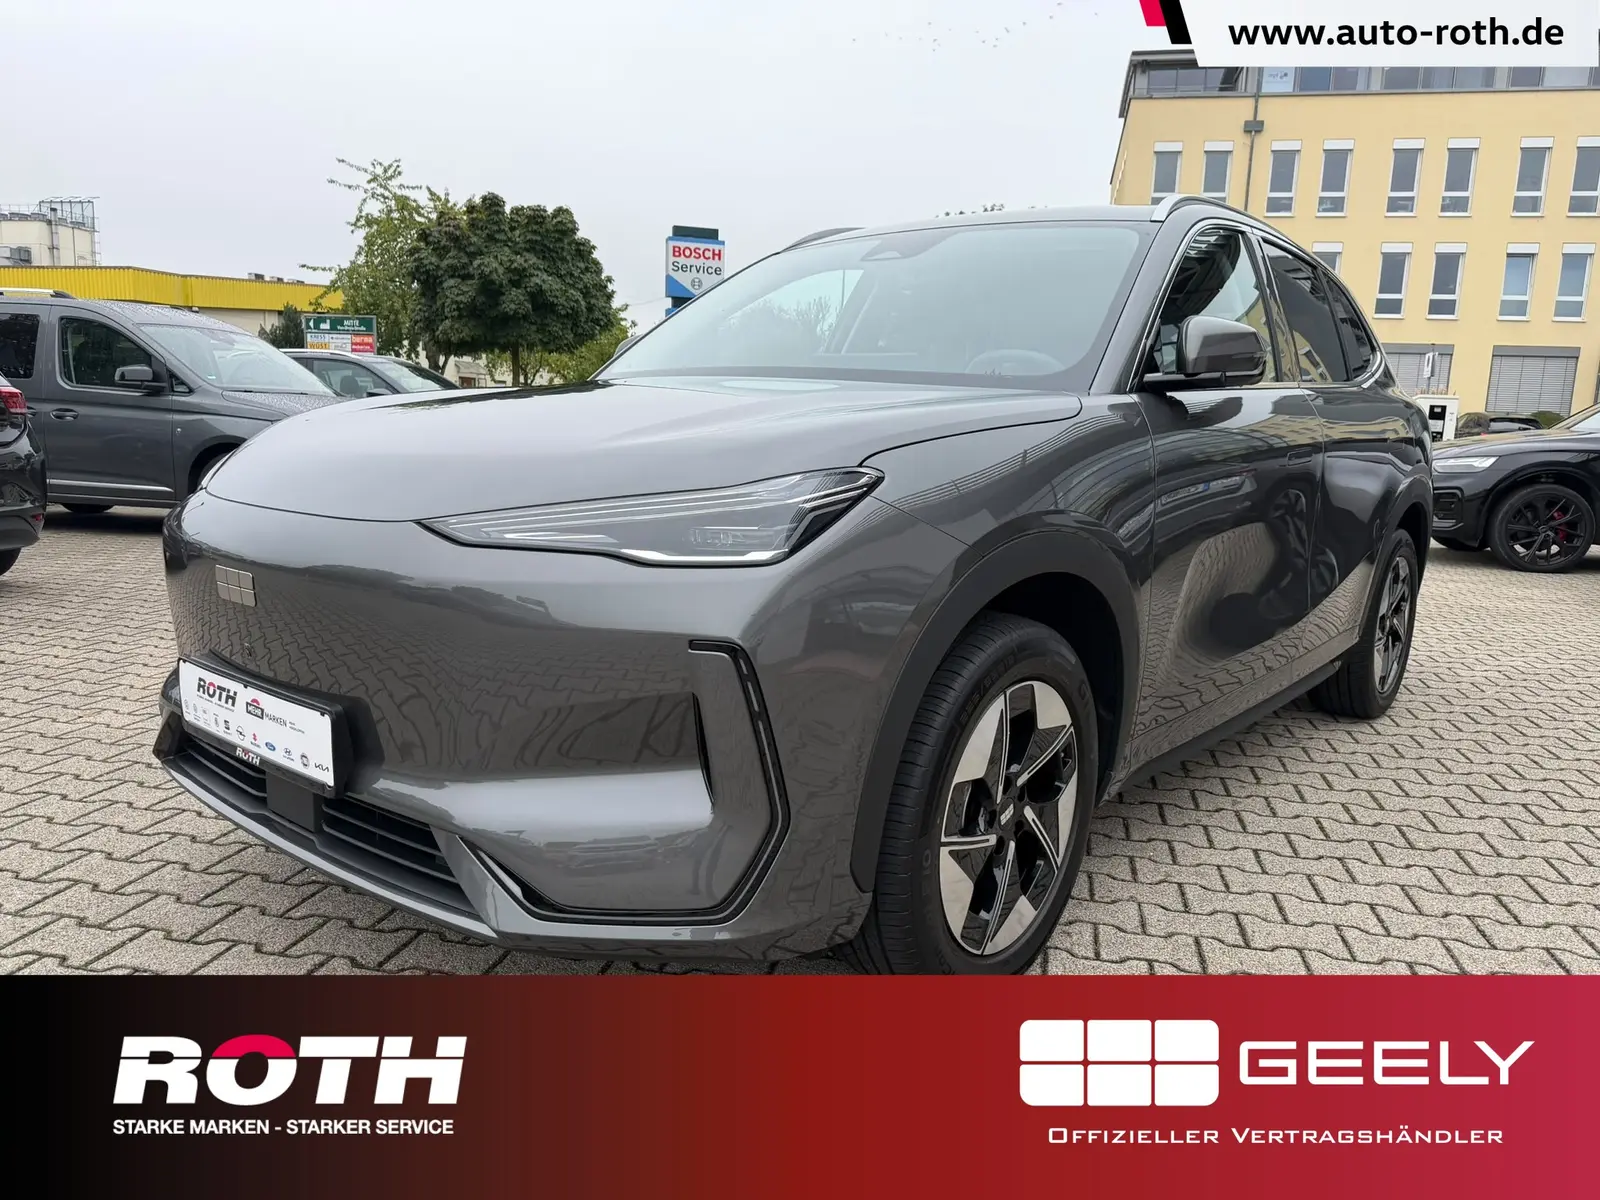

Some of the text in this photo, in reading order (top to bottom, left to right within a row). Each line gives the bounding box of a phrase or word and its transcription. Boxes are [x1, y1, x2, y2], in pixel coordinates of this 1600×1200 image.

[672, 245, 722, 261] BOSCH
[671, 261, 722, 276] Service
[197, 677, 238, 707] ROTH
[264, 712, 288, 727] MARKEN
[235, 747, 260, 766] ROTH
